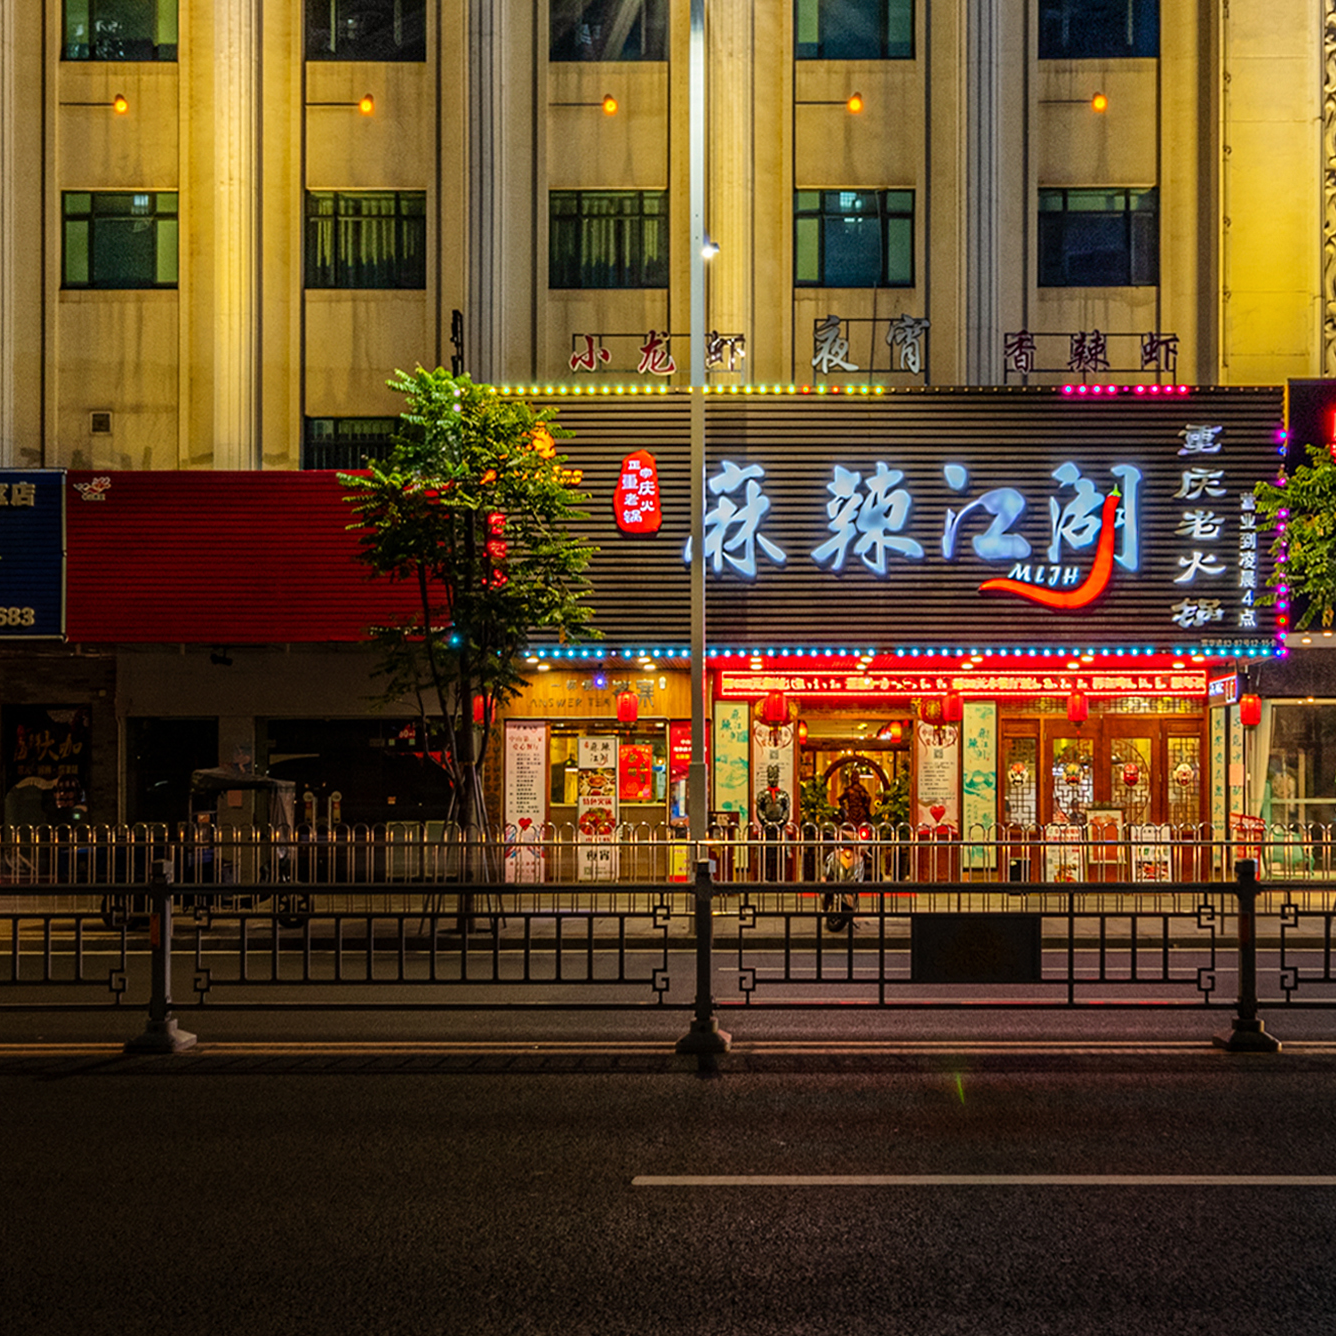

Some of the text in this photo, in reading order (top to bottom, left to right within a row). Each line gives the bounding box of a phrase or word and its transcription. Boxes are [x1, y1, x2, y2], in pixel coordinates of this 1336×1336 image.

[569, 329, 746, 375] 小龙虾
[812, 314, 930, 374] 夜宵
[1004, 329, 1180, 374] 香辣虾
[683, 460, 1143, 580] 麻辣江湖
[1171, 423, 1227, 629] 重庆老火锅
[1238, 491, 1257, 628] 营业到凌晨4点
